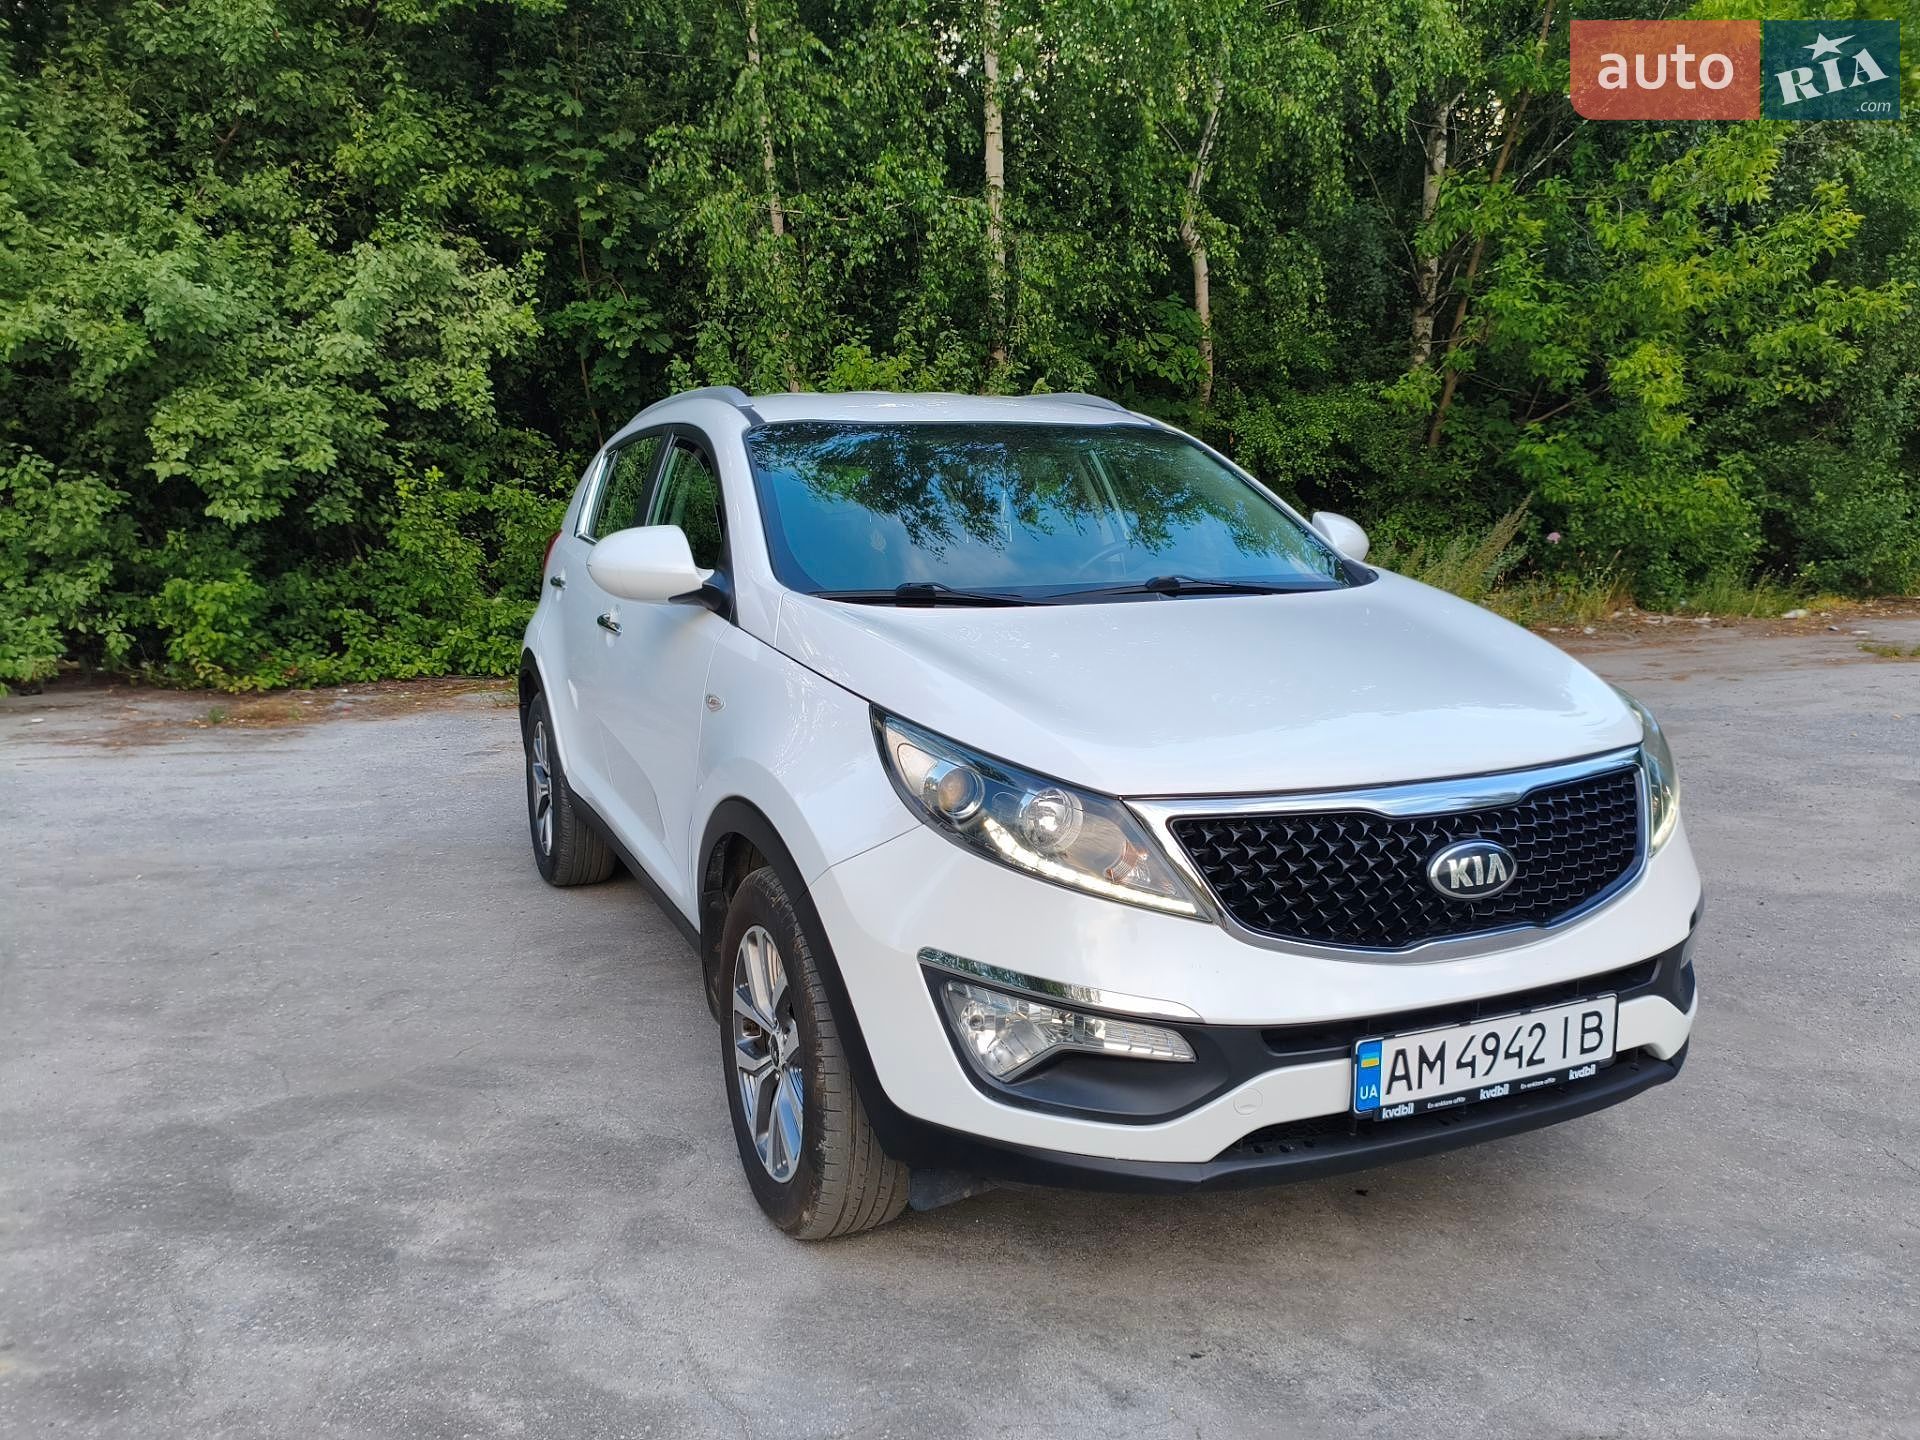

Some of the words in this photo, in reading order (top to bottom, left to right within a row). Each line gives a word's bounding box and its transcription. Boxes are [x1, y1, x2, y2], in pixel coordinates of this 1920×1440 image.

[1447, 853, 1508, 889] KIA
[1385, 1040, 1447, 1096] AM
[1456, 1022, 1547, 1079] 4942
[1561, 1009, 1604, 1060] IB
[1359, 1085, 1379, 1101] UA
[1381, 1102, 1415, 1120] kvdbil
[1479, 1083, 1510, 1101] kvdbil
[1568, 1064, 1597, 1081] kvdbil
